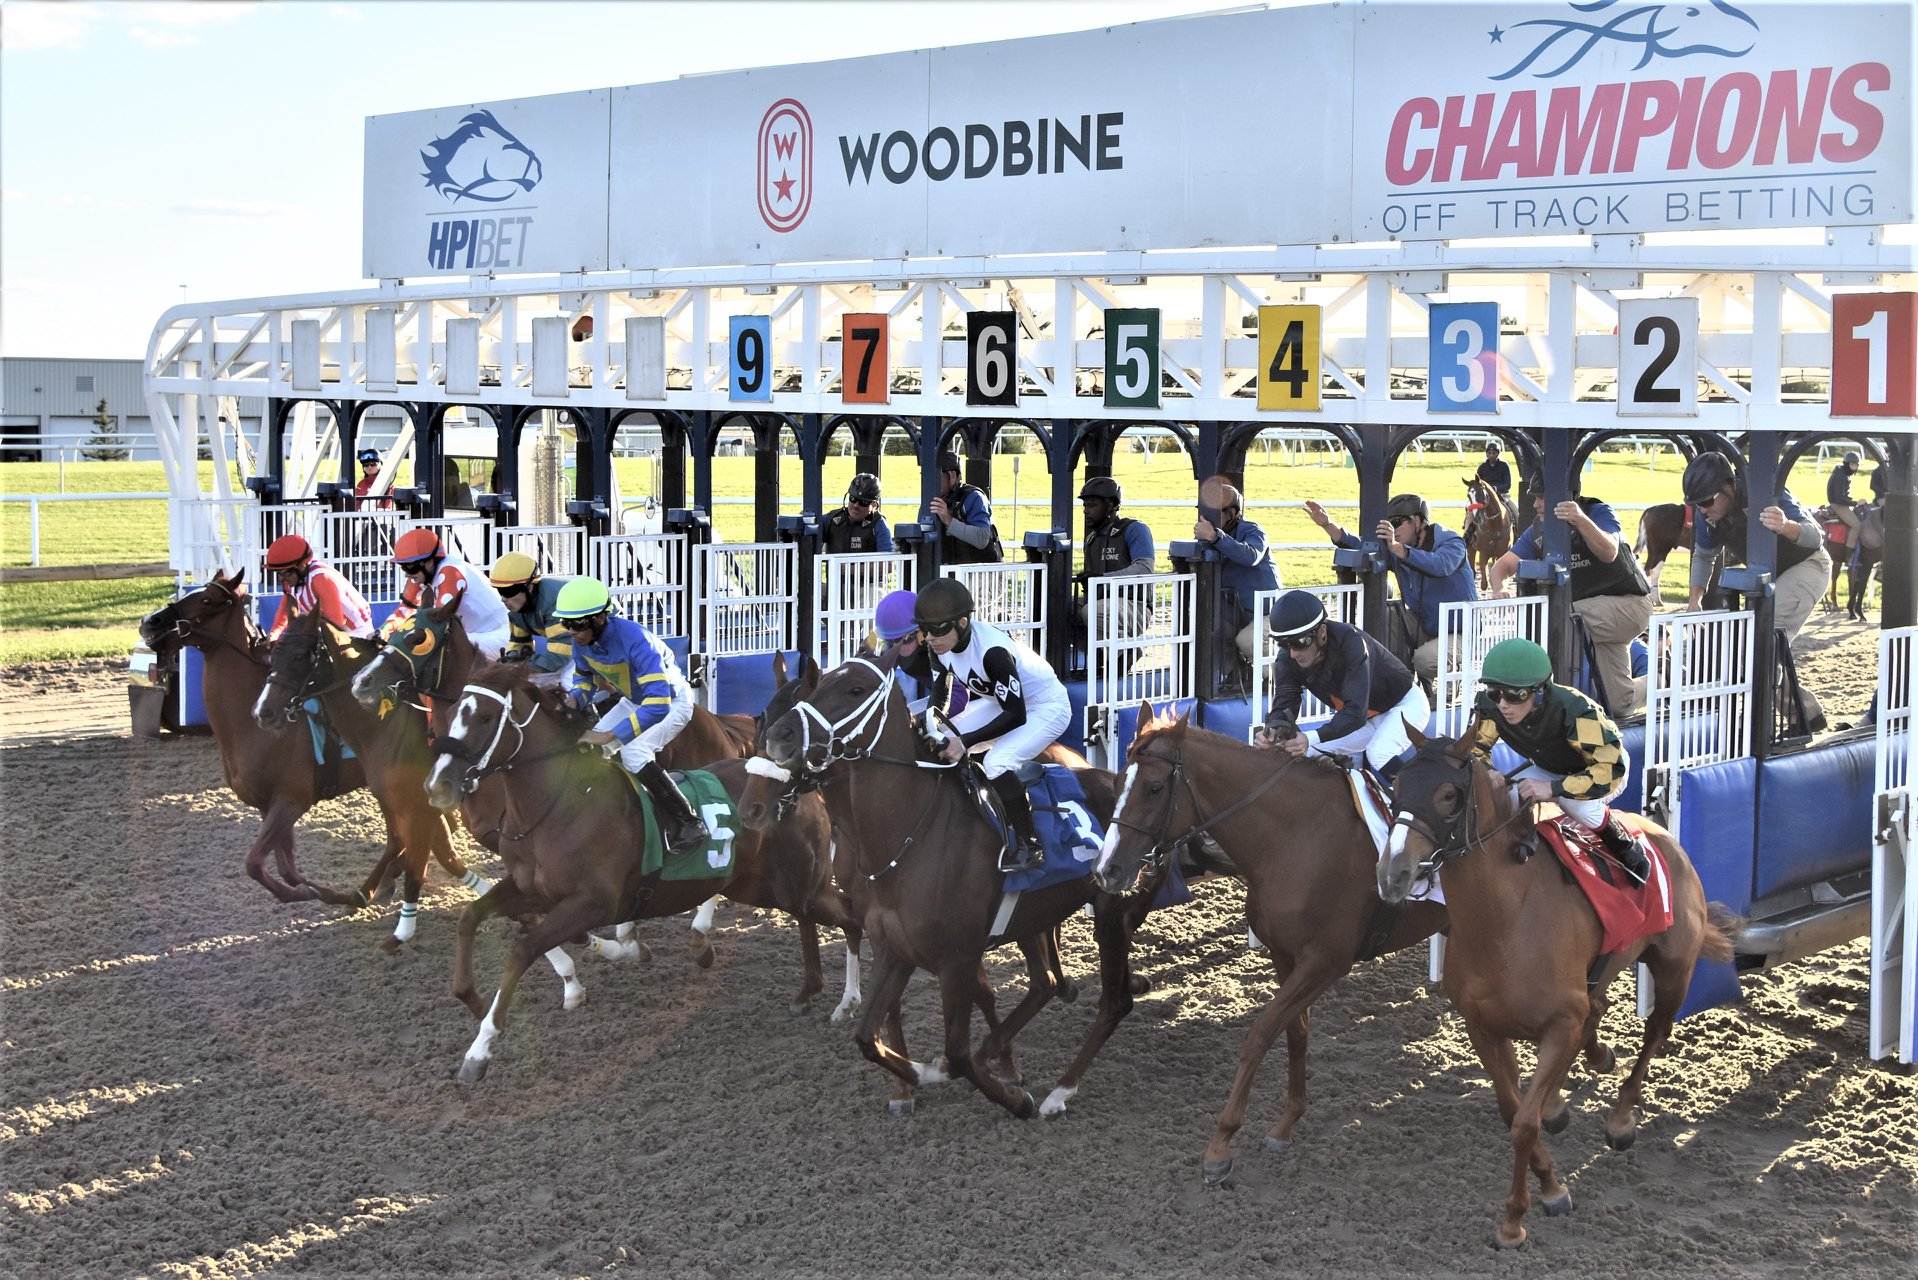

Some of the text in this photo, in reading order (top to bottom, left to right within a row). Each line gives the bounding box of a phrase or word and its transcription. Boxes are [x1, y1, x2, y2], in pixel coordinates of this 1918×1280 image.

[773, 132, 798, 161] W
[839, 112, 1123, 186] WOODBINE
[1385, 61, 1891, 186] CHAMPIONS
[428, 216, 534, 270] HPIBET
[1382, 184, 1874, 233] OFF TRACK BETTING
[736, 328, 764, 394] 9
[850, 328, 880, 394] 7
[976, 325, 1009, 398] 6
[1115, 324, 1150, 399] 5
[1269, 320, 1309, 399] 4
[1441, 318, 1484, 403] 3
[1633, 316, 1681, 403] 2
[1852, 310, 1888, 404] 1
[968, 677, 989, 694] C
[701, 803, 735, 869] 5
[1057, 800, 1104, 862] 3
